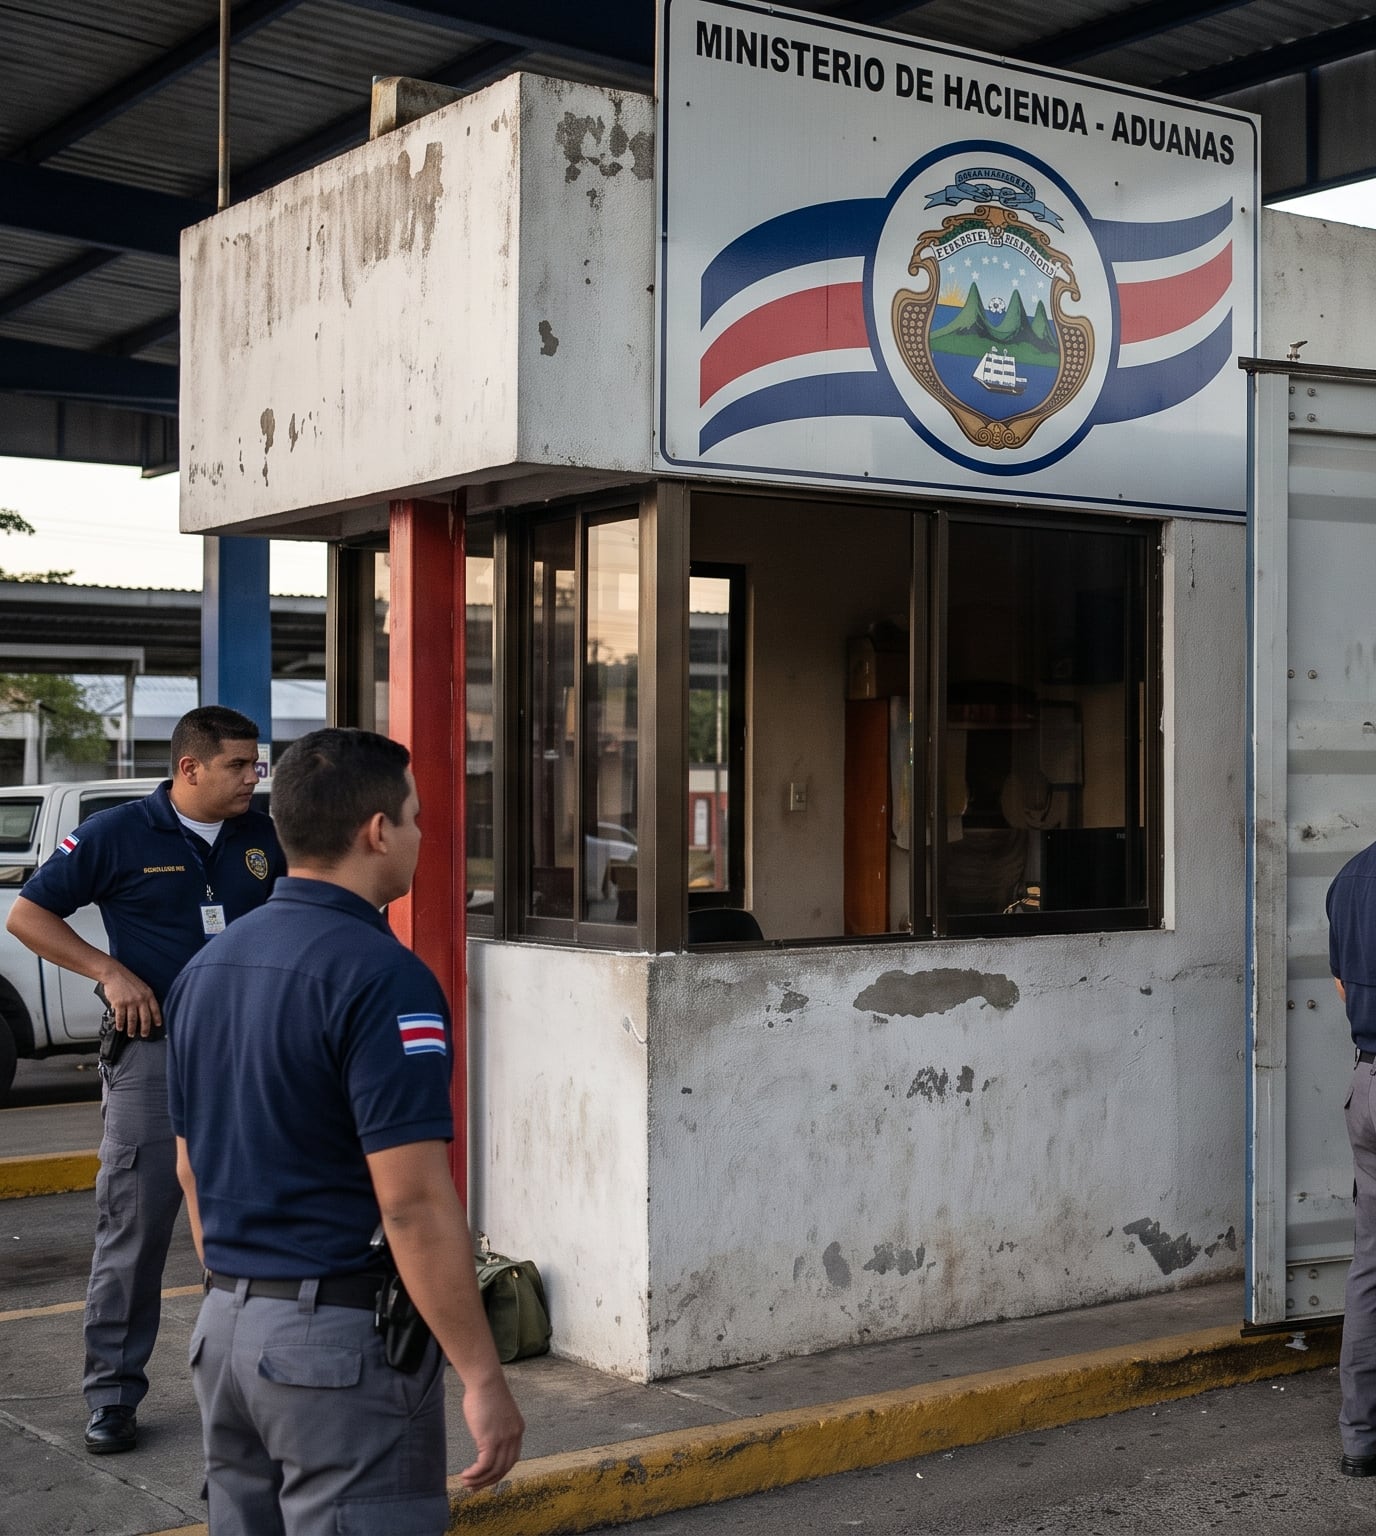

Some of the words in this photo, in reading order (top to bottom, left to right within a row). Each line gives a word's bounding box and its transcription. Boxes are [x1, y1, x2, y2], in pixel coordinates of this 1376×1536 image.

[696, 19, 886, 93] MINISTERIO
[895, 62, 935, 104] DE
[943, 73, 1090, 136] HACIENDA
[1096, 122, 1105, 131] -
[1111, 111, 1235, 166] ADUANAS
